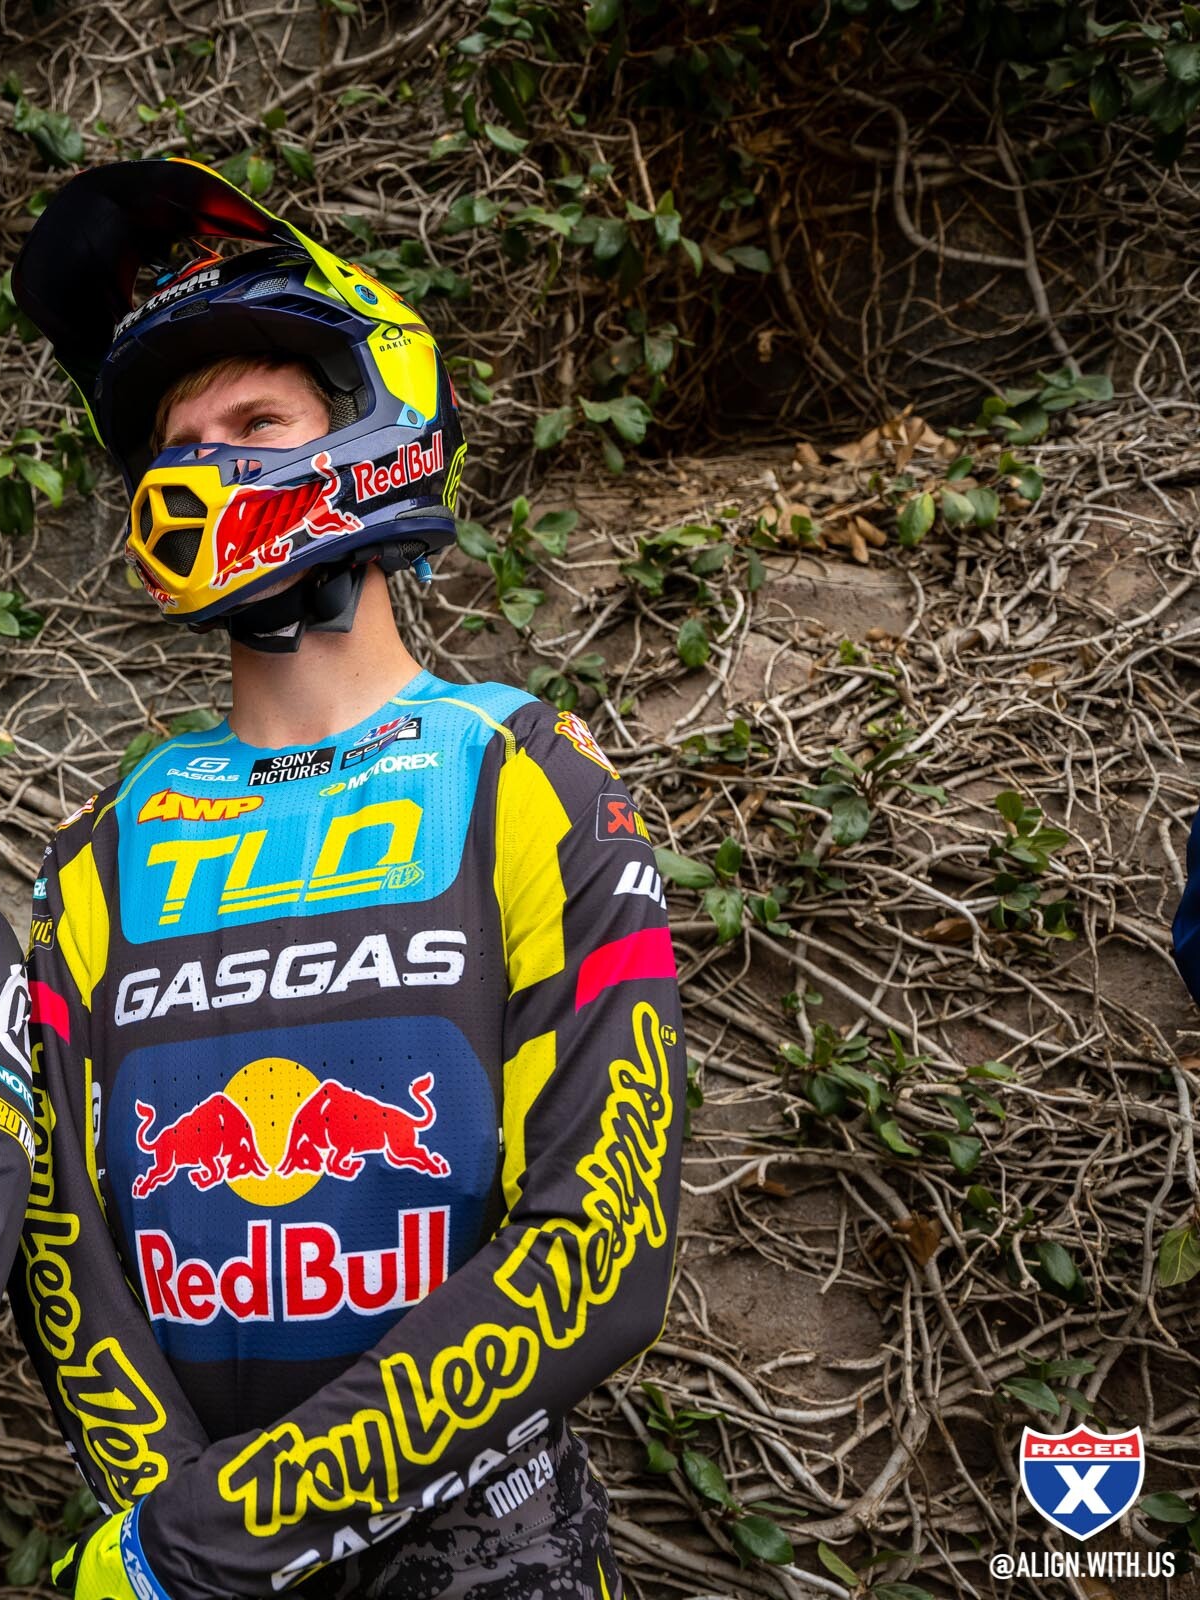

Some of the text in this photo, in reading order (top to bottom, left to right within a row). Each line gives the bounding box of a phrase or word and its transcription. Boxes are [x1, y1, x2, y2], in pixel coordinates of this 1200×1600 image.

[379, 338, 412, 352] OAKLEY
[351, 429, 444, 504] Red Bull
[166, 768, 240, 783] GASGAS
[249, 761, 331, 786] PICTURES
[271, 750, 317, 770] SONY
[347, 752, 439, 791] MOTOREX
[114, 930, 467, 1027] GASGAS
[135, 1205, 451, 1325] Red Bull
[218, 1001, 673, 1537] Troy Lee Designs
